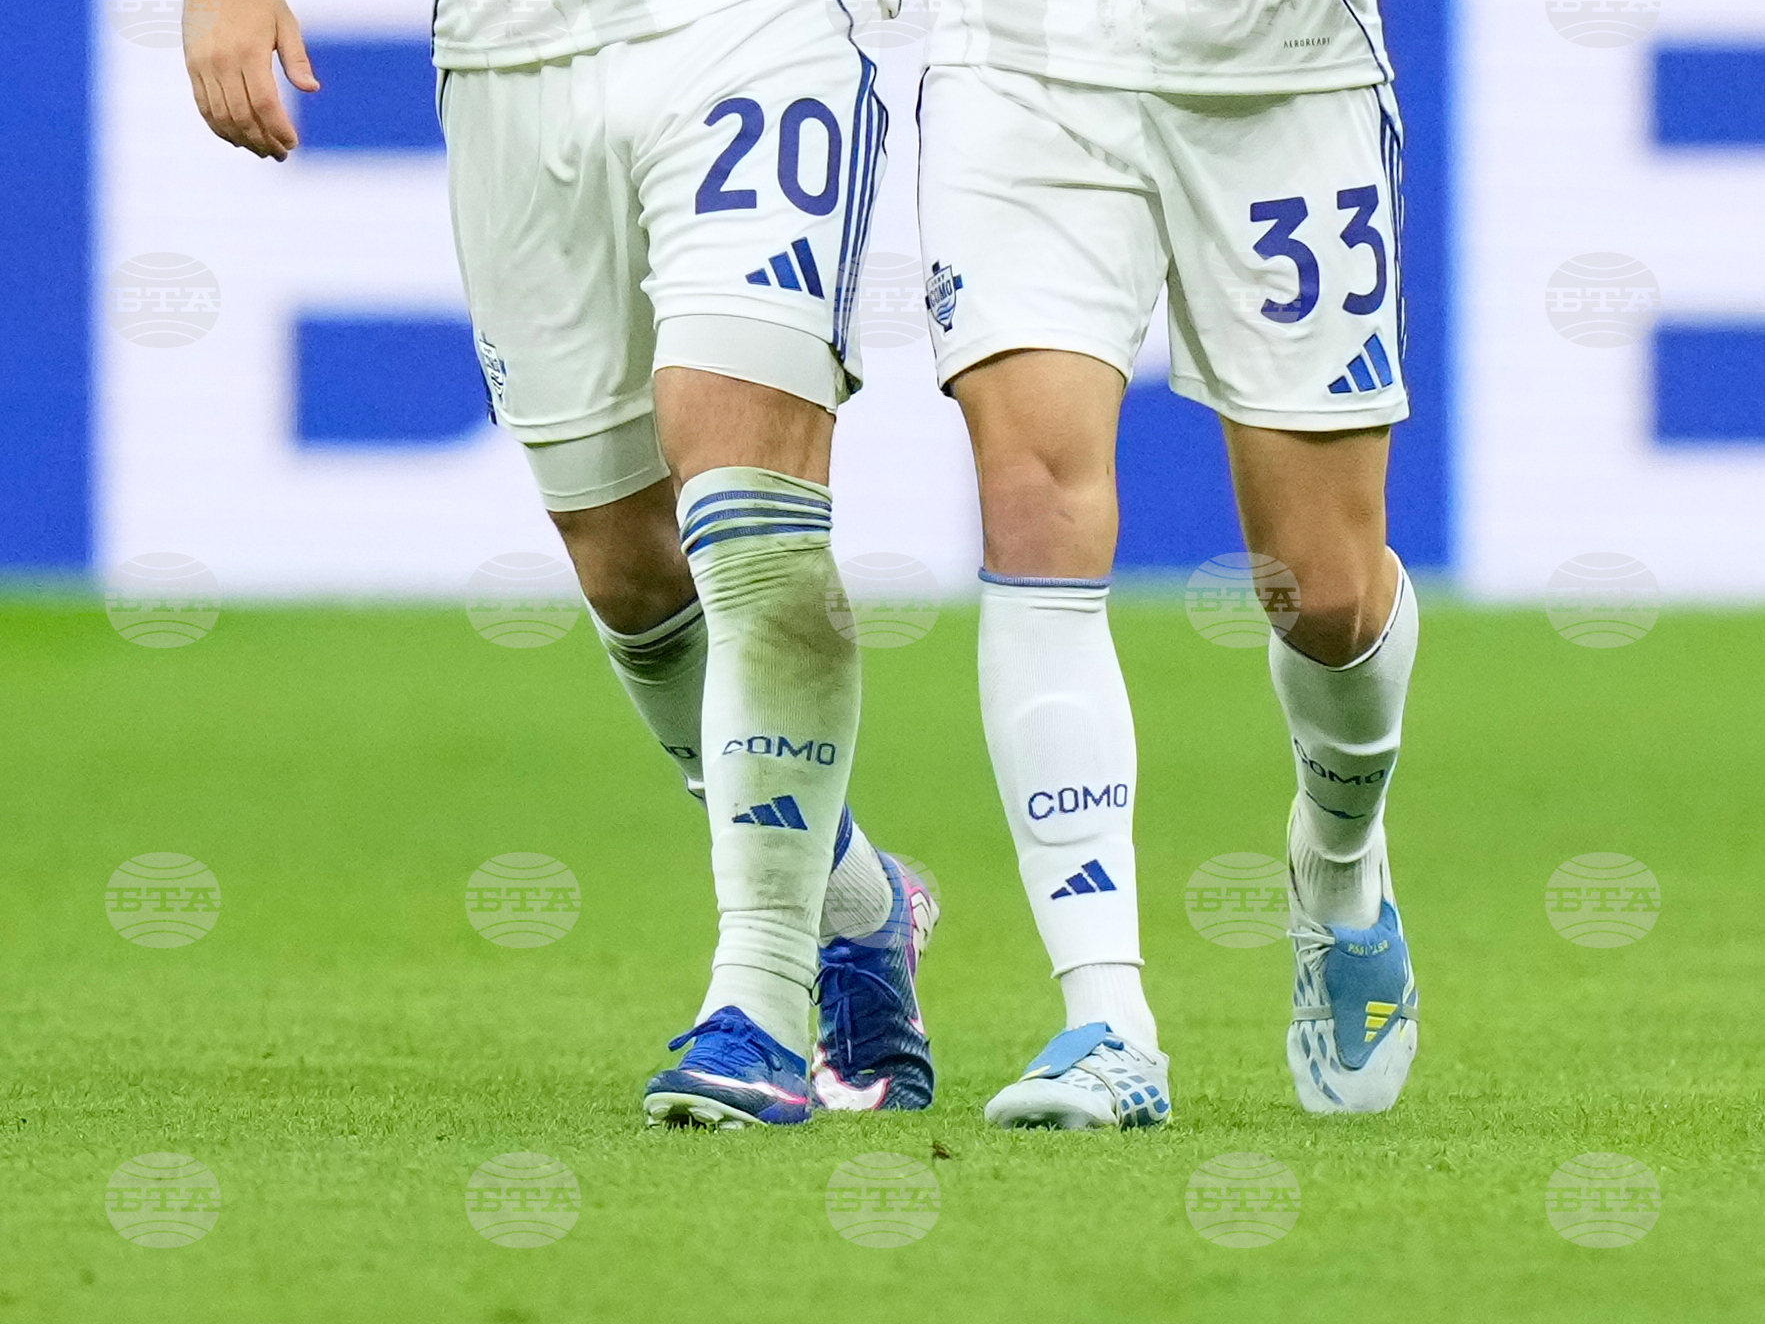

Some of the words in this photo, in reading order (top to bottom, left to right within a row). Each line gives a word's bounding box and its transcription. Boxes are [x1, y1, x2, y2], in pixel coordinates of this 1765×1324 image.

[695, 97, 843, 217] 20
[1250, 184, 1388, 324] 33
[722, 735, 837, 766] COMO
[1028, 783, 1128, 821] COMO
